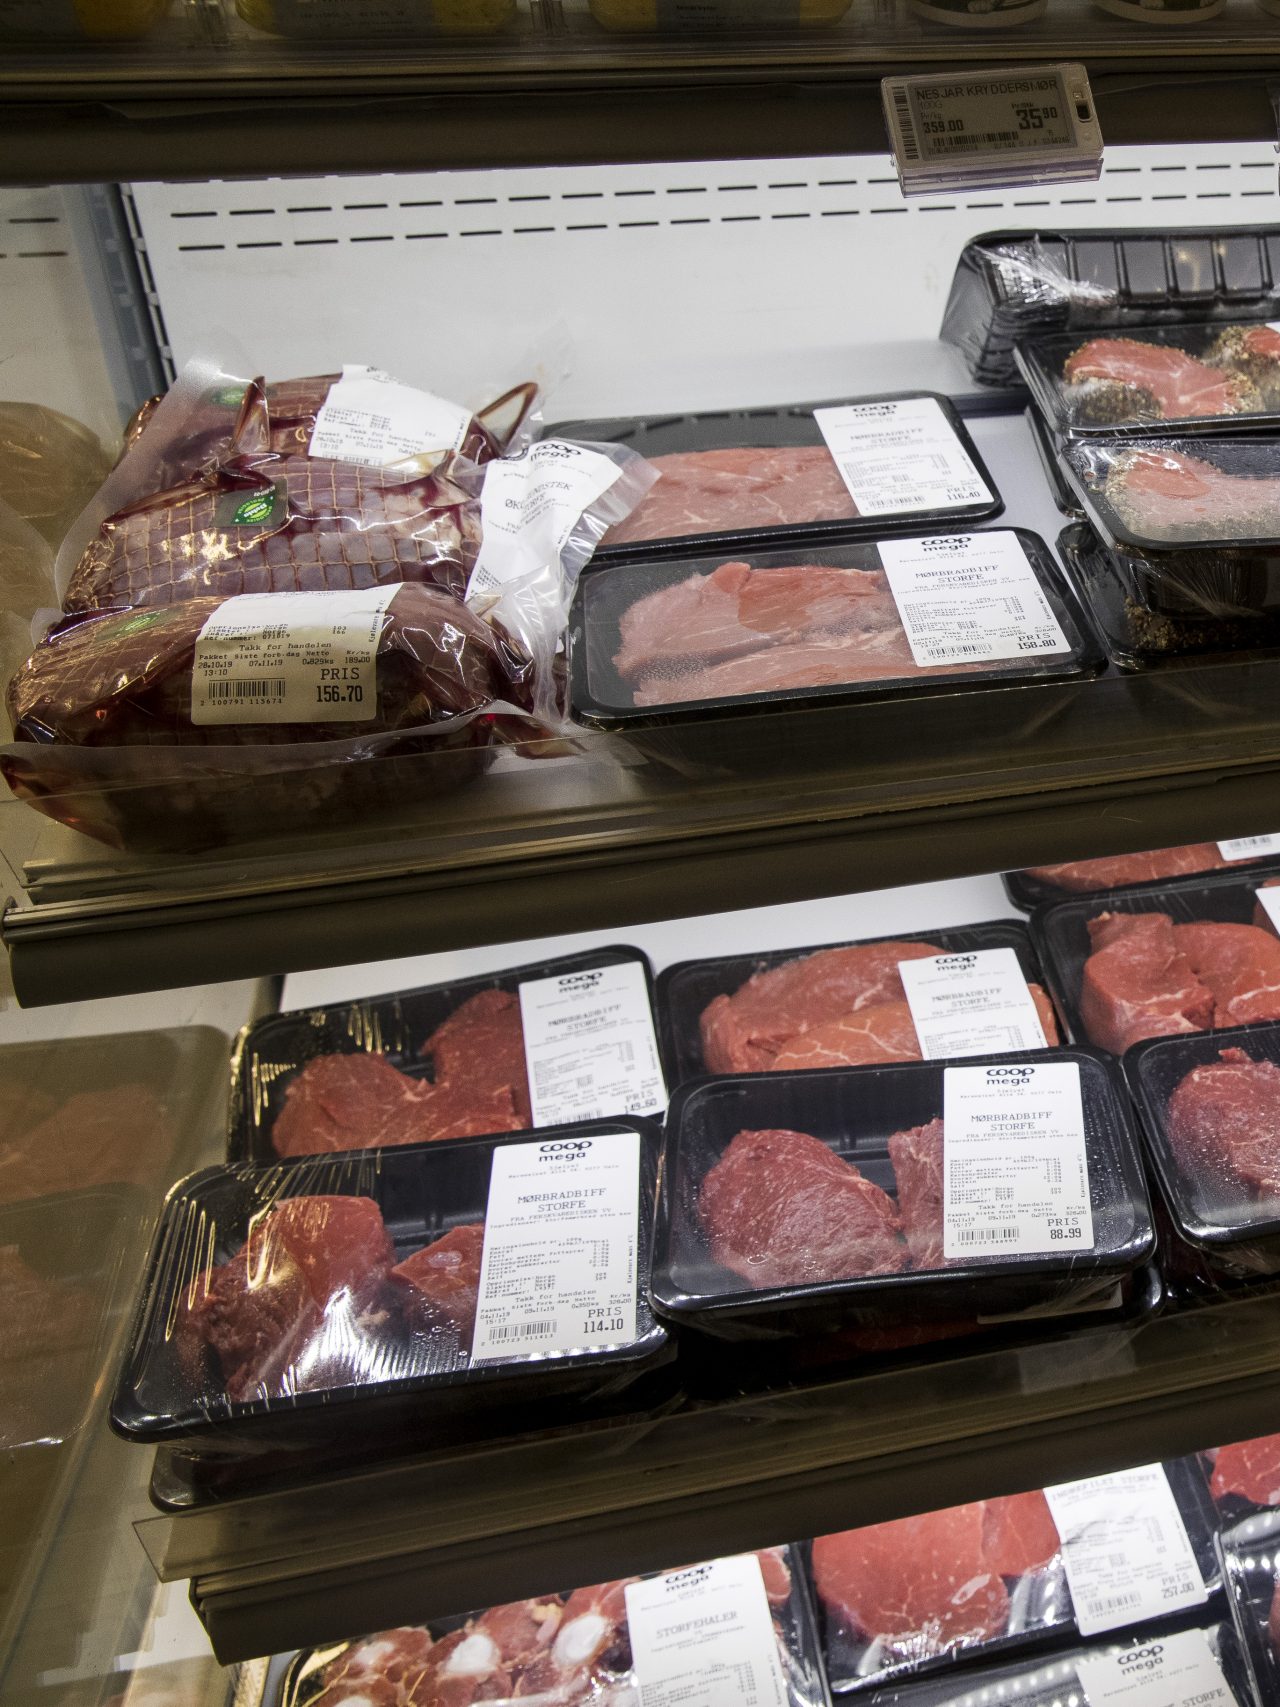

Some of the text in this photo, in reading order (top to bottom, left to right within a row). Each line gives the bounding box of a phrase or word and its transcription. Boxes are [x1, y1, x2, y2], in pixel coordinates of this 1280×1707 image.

[916, 79, 1058, 100] NESJAR KRYDDERSMØR
[923, 119, 964, 134] 359.00
[852, 404, 897, 412] coop
[535, 443, 582, 457] coop
[921, 536, 972, 546] coop
[923, 543, 969, 552] mega
[915, 565, 999, 579] MØRBRADBIFF
[938, 574, 985, 583] STORFE
[1018, 632, 1051, 642] PRIS
[288, 642, 332, 650] handelen
[1017, 639, 1058, 650] 158.80
[248, 659, 283, 667] 07.11.19
[320, 668, 360, 680] PRIS
[316, 685, 363, 703] 156.70
[935, 954, 978, 965] coop
[937, 963, 975, 972] mega
[558, 971, 603, 986] coop
[559, 981, 600, 993] mega
[986, 1067, 1035, 1077] coop
[986, 1077, 1031, 1087] mega
[971, 1111, 1053, 1123] MØRBRADBIFF
[990, 1121, 1036, 1132] STORFE
[539, 1141, 593, 1152] coop
[539, 1152, 587, 1162] mega
[517, 1188, 607, 1204] MØRBRADBIFF
[537, 1200, 587, 1213] STORFE
[1047, 1217, 1079, 1227] PRIS
[1050, 1228, 1082, 1240] 88.99
[558, 1289, 597, 1298] handelen
[588, 1306, 622, 1318] PRIS
[583, 1318, 624, 1334] 114.10
[665, 1564, 713, 1585] coop
[666, 1575, 709, 1593] mega
[656, 1611, 739, 1640] STORFEHALER
[1117, 1645, 1164, 1666] coop
[1121, 1656, 1164, 1676] mega
[1182, 1688, 1226, 1707] STORFE
